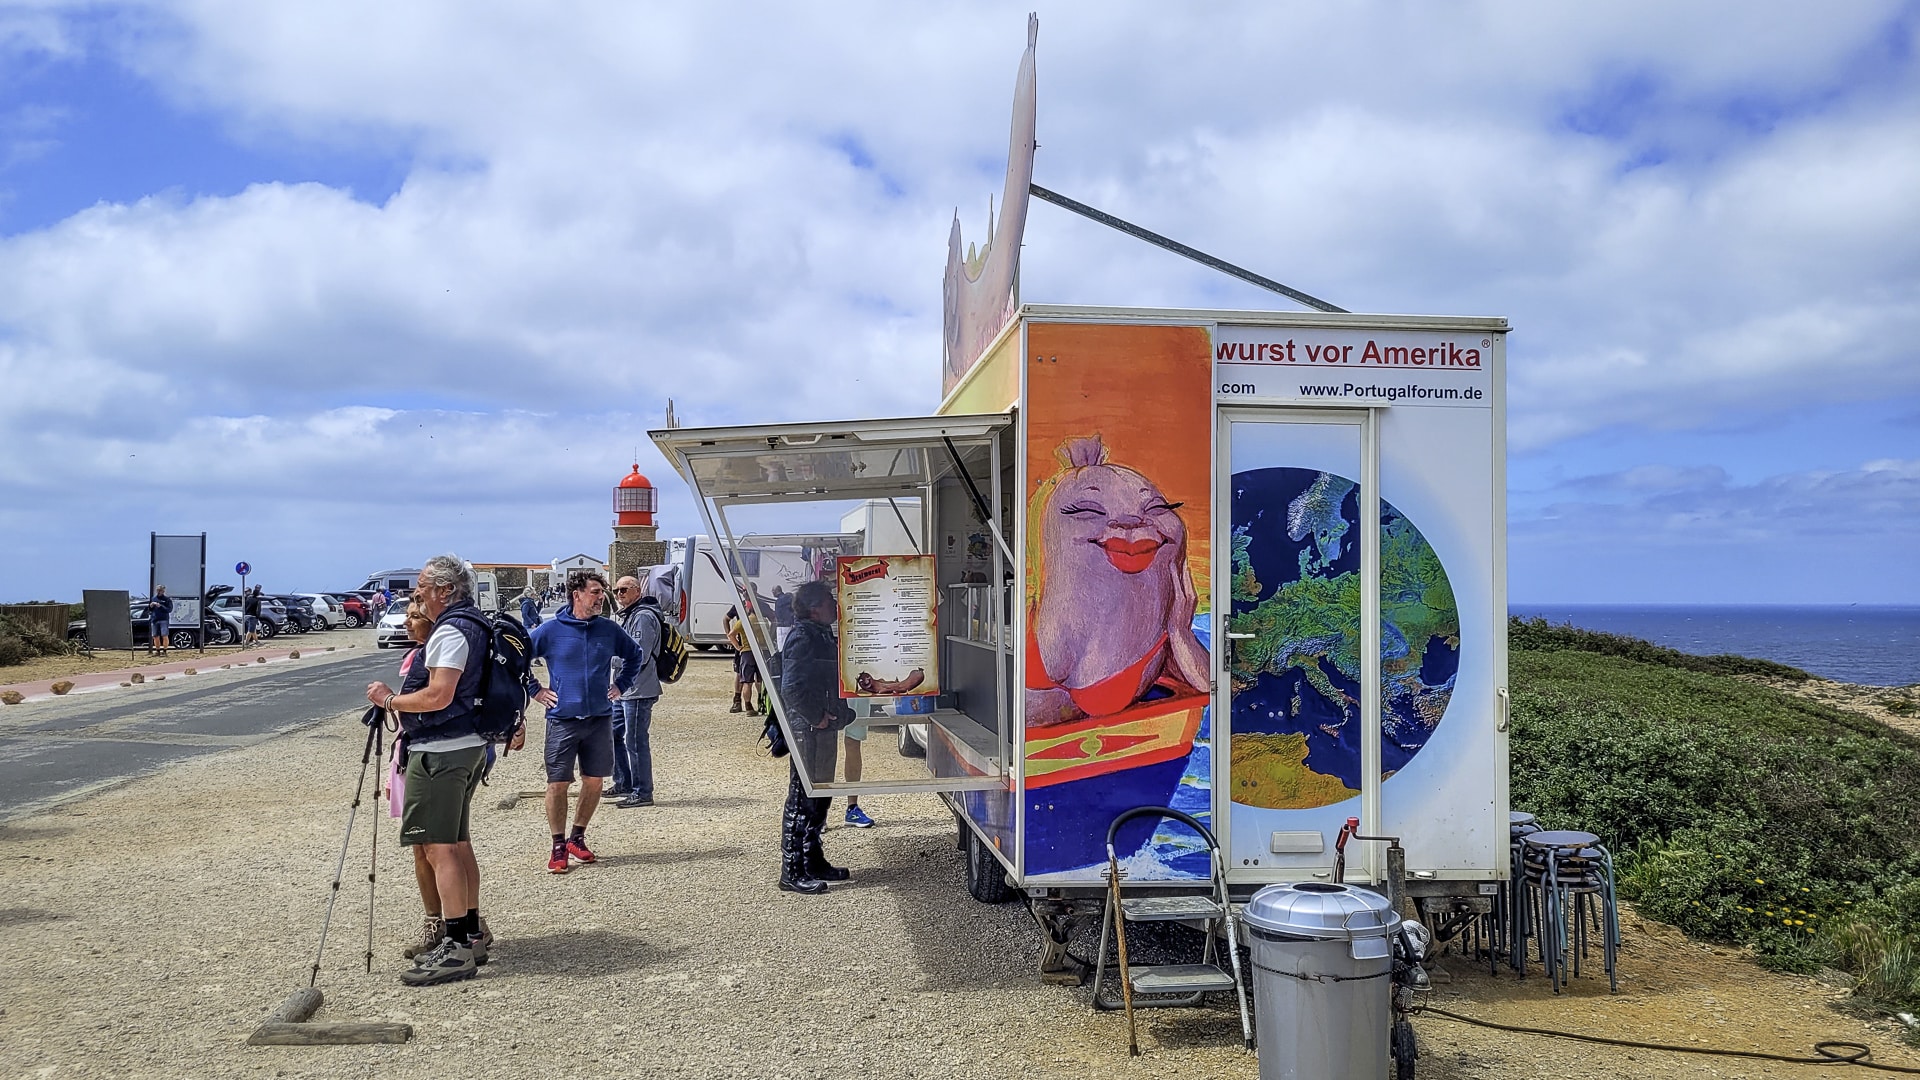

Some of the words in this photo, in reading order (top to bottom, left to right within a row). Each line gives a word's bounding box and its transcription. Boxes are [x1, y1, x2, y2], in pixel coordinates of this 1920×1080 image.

[1217, 339, 1296, 361] wurst
[1305, 345, 1353, 363] vor
[1217, 382, 1256, 394] .com
[1300, 383, 1483, 400] www.Portugalforum.de
